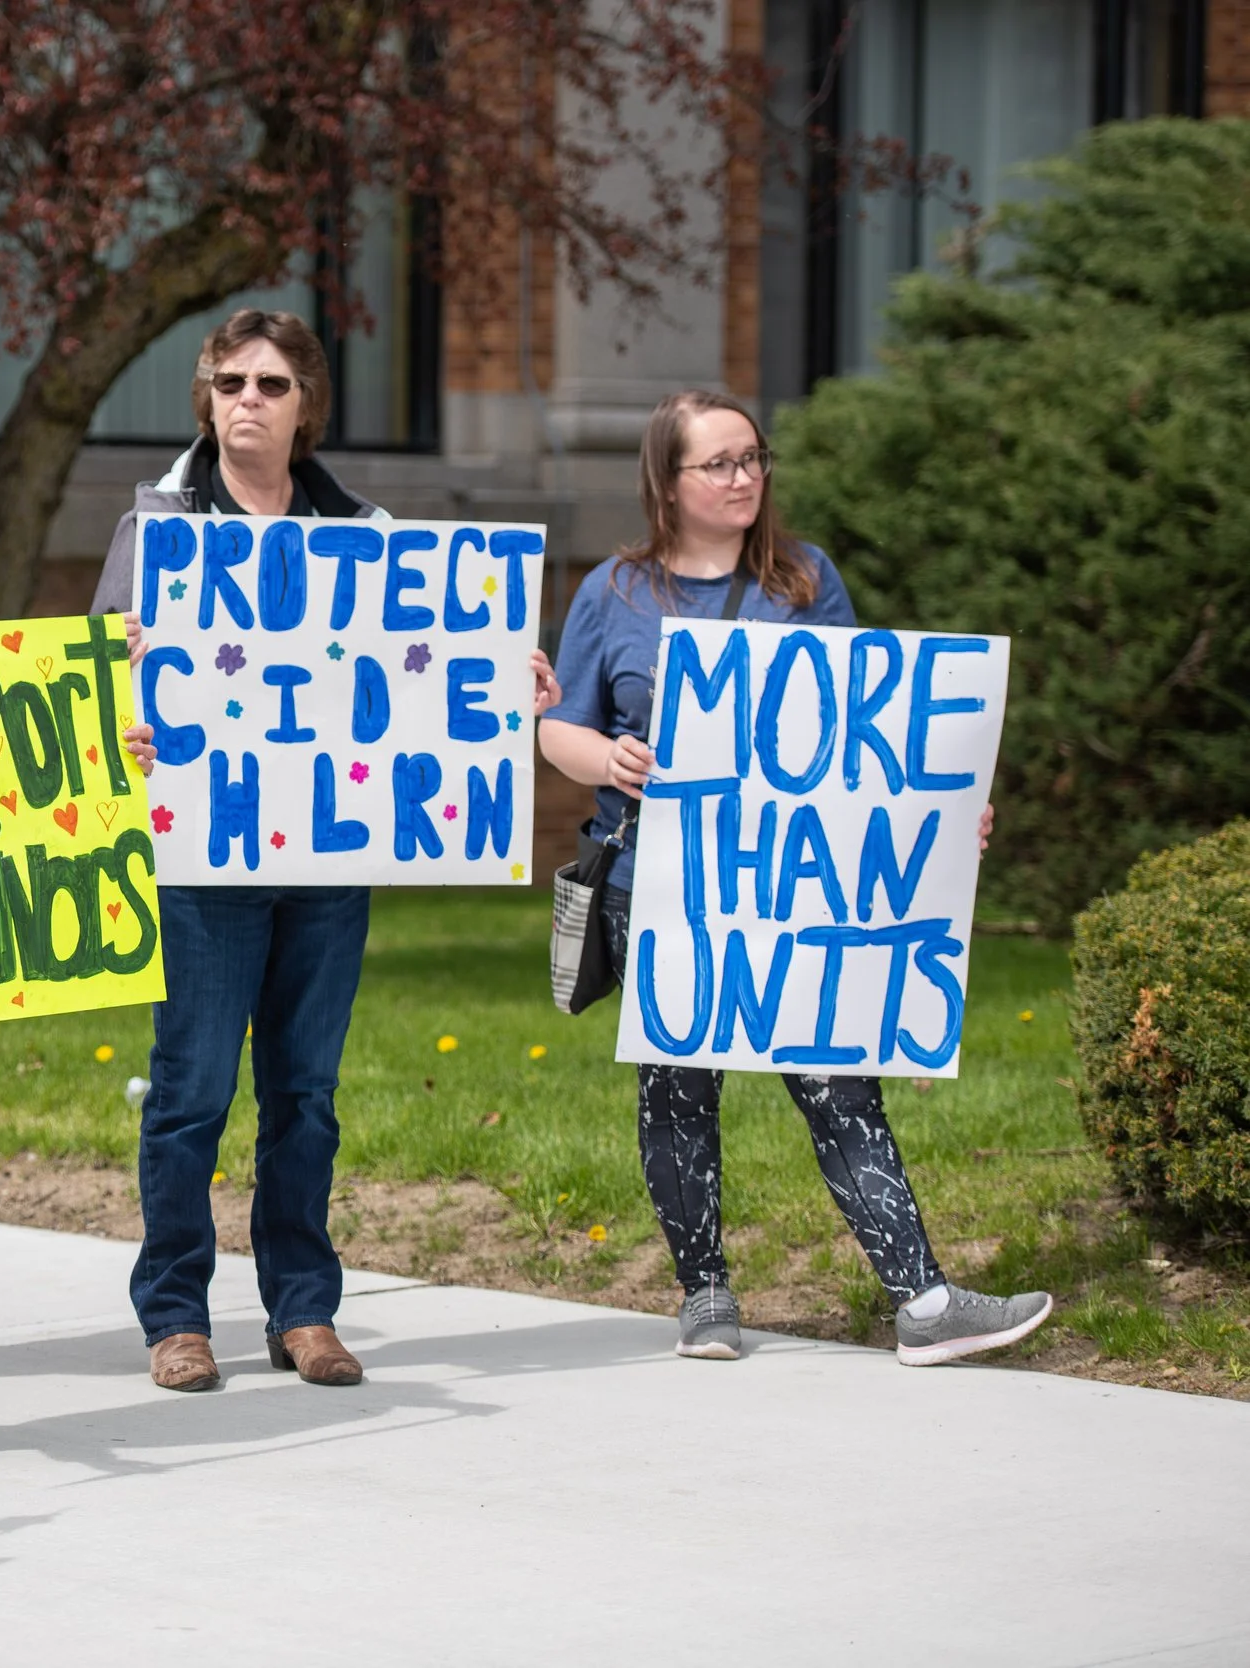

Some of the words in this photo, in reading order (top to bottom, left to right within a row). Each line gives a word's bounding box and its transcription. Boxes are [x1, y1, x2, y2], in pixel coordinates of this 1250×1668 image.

[141, 518, 543, 632] PROTECT
[655, 628, 990, 795] MORE
[642, 776, 941, 925] THAN
[637, 918, 965, 1069] UNITS
